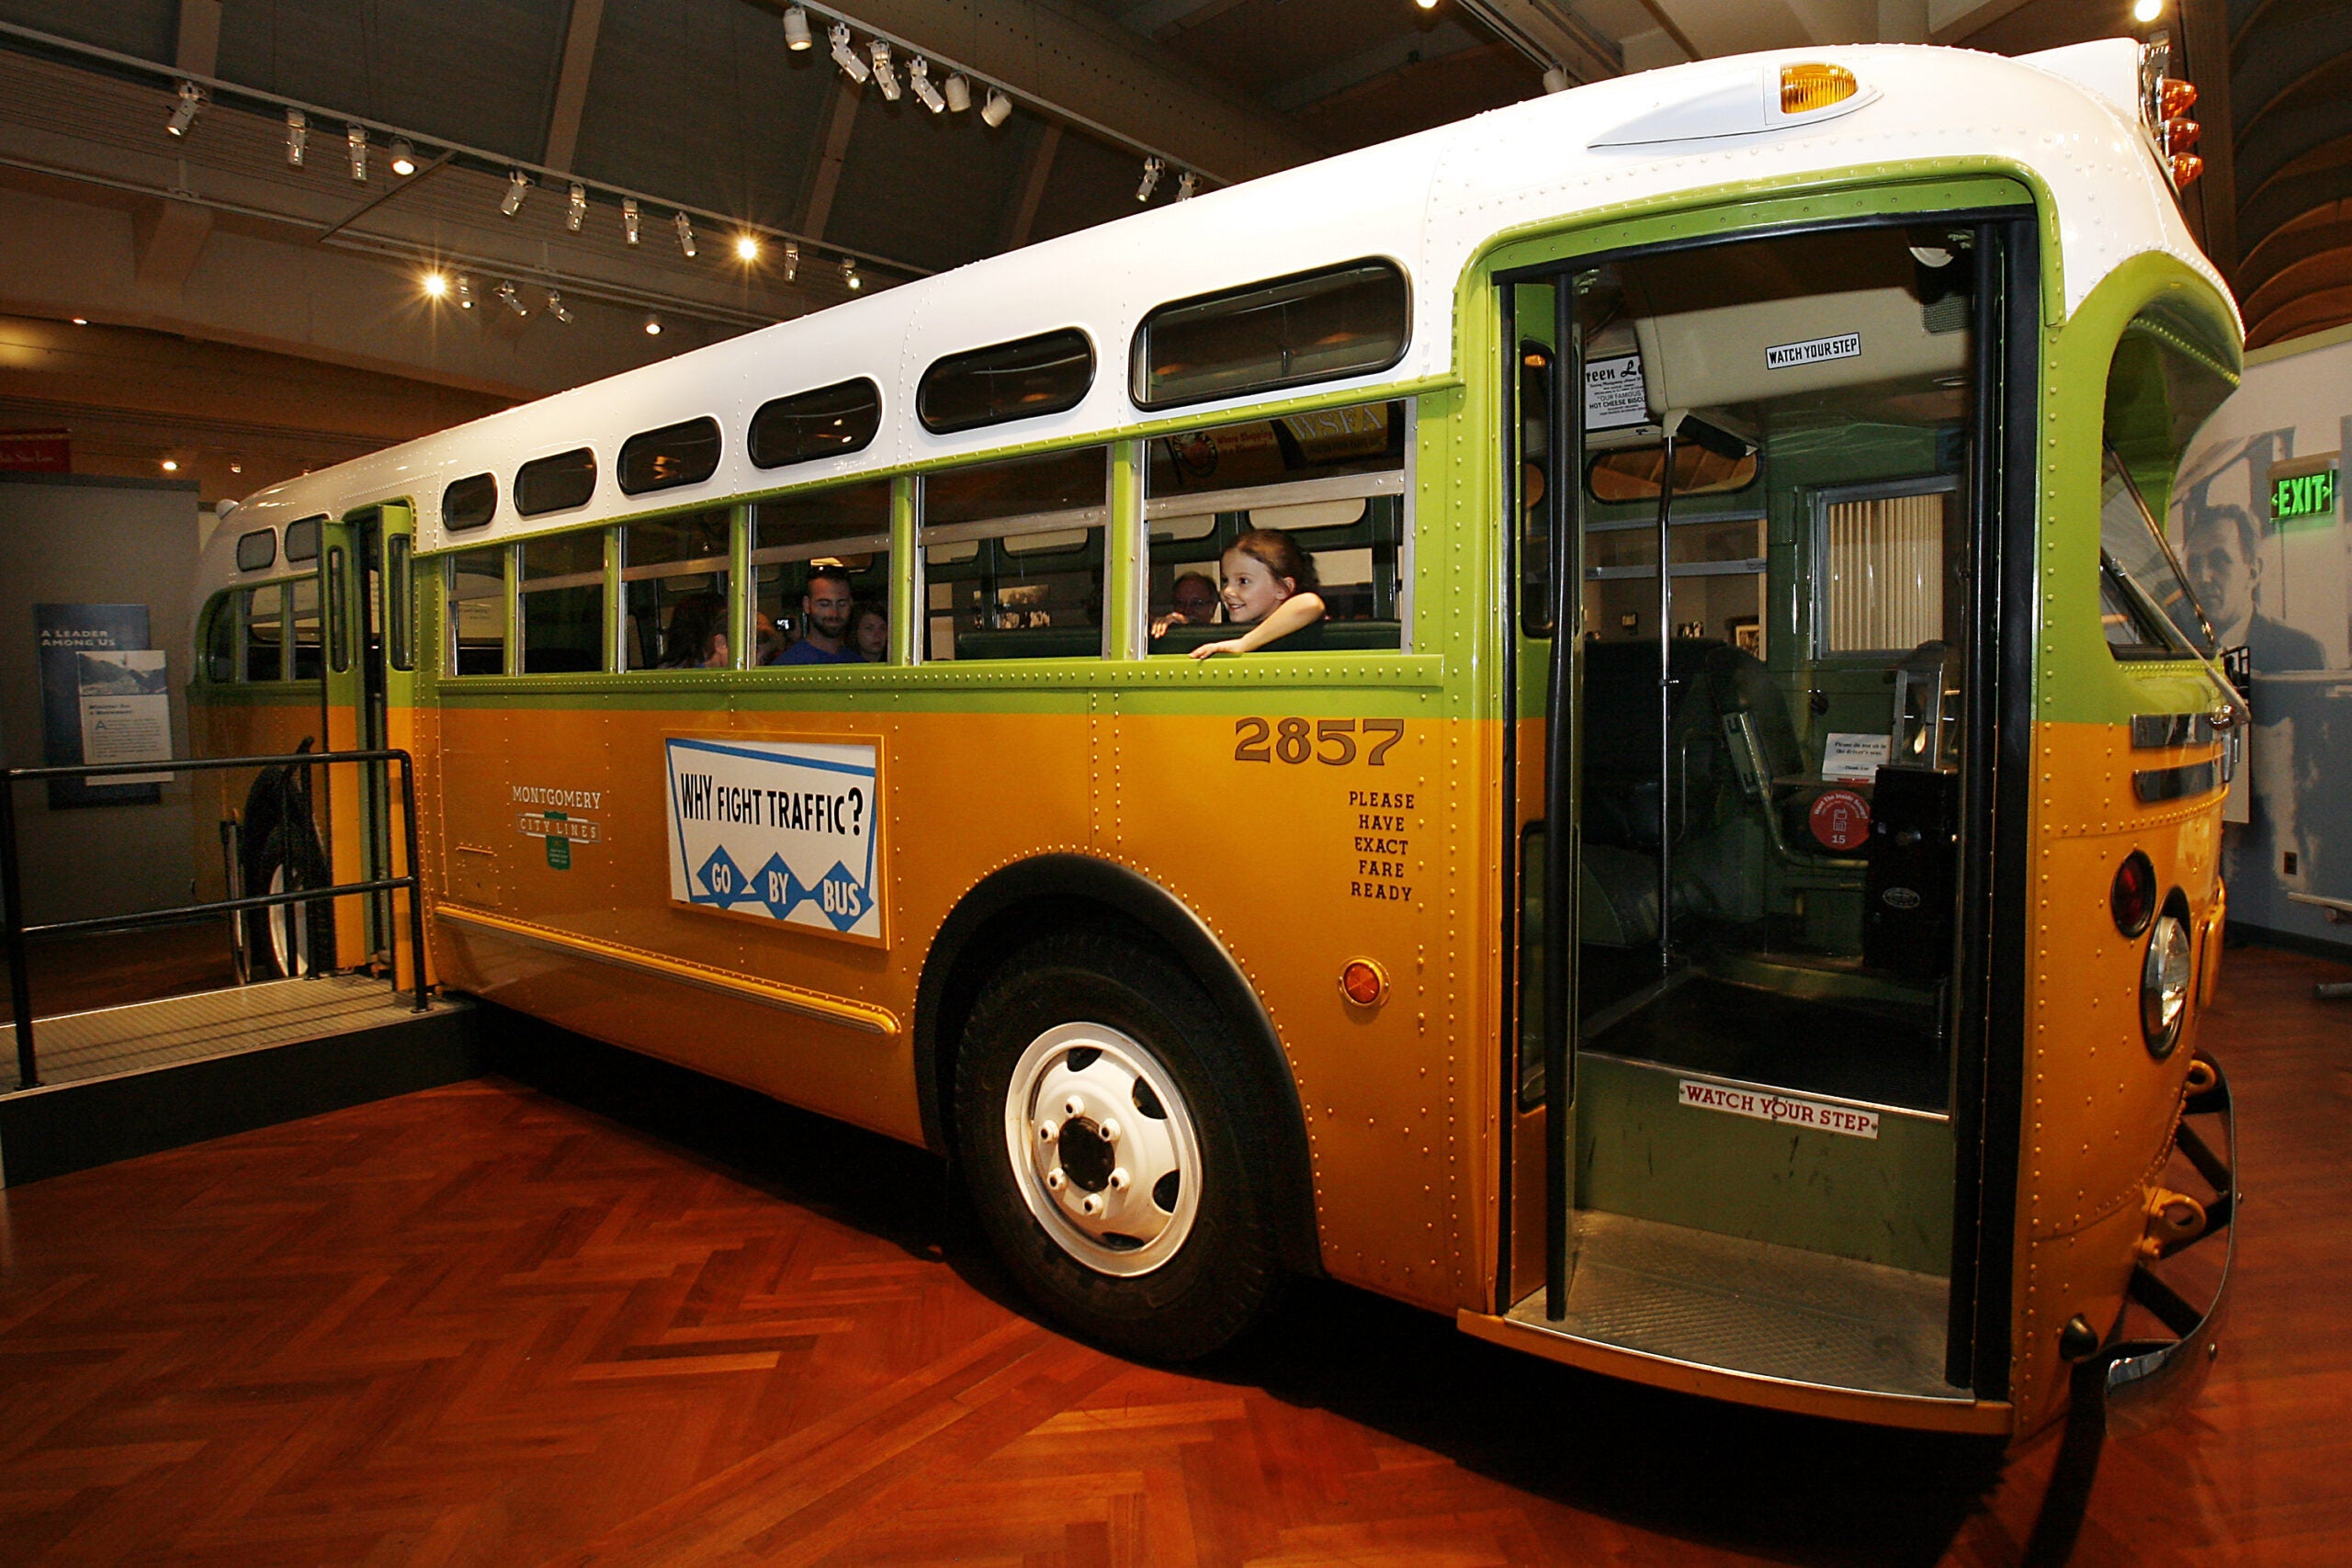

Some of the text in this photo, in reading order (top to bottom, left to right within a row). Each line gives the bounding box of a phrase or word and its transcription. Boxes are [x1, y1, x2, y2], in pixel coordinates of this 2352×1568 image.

[1769, 338, 1857, 364] WATCH YOUR STEP
[1586, 368, 1615, 382] reen
[1603, 399, 1626, 408] CHEESE
[1628, 396, 1646, 404] BISCU
[1288, 407, 1383, 440] WSFA
[2278, 474, 2325, 515] EXIT
[41, 638, 94, 647] AMONG
[1235, 716, 1405, 766] 2857
[513, 785, 601, 809] MONTGOMERY
[681, 773, 712, 820] WHY
[718, 786, 762, 825] FIGHT
[1349, 791, 1415, 809] PLEASE
[520, 818, 596, 839] CITY LINES
[1359, 814, 1405, 831] HAVE
[1354, 837, 1408, 855] EXACT
[1831, 834, 1846, 844] 15
[1359, 860, 1404, 878] FARE
[711, 863, 862, 917] GO BY BUS
[1351, 882, 1412, 901] READY
[1686, 1085, 1871, 1132] WATCH YOUR STEP
